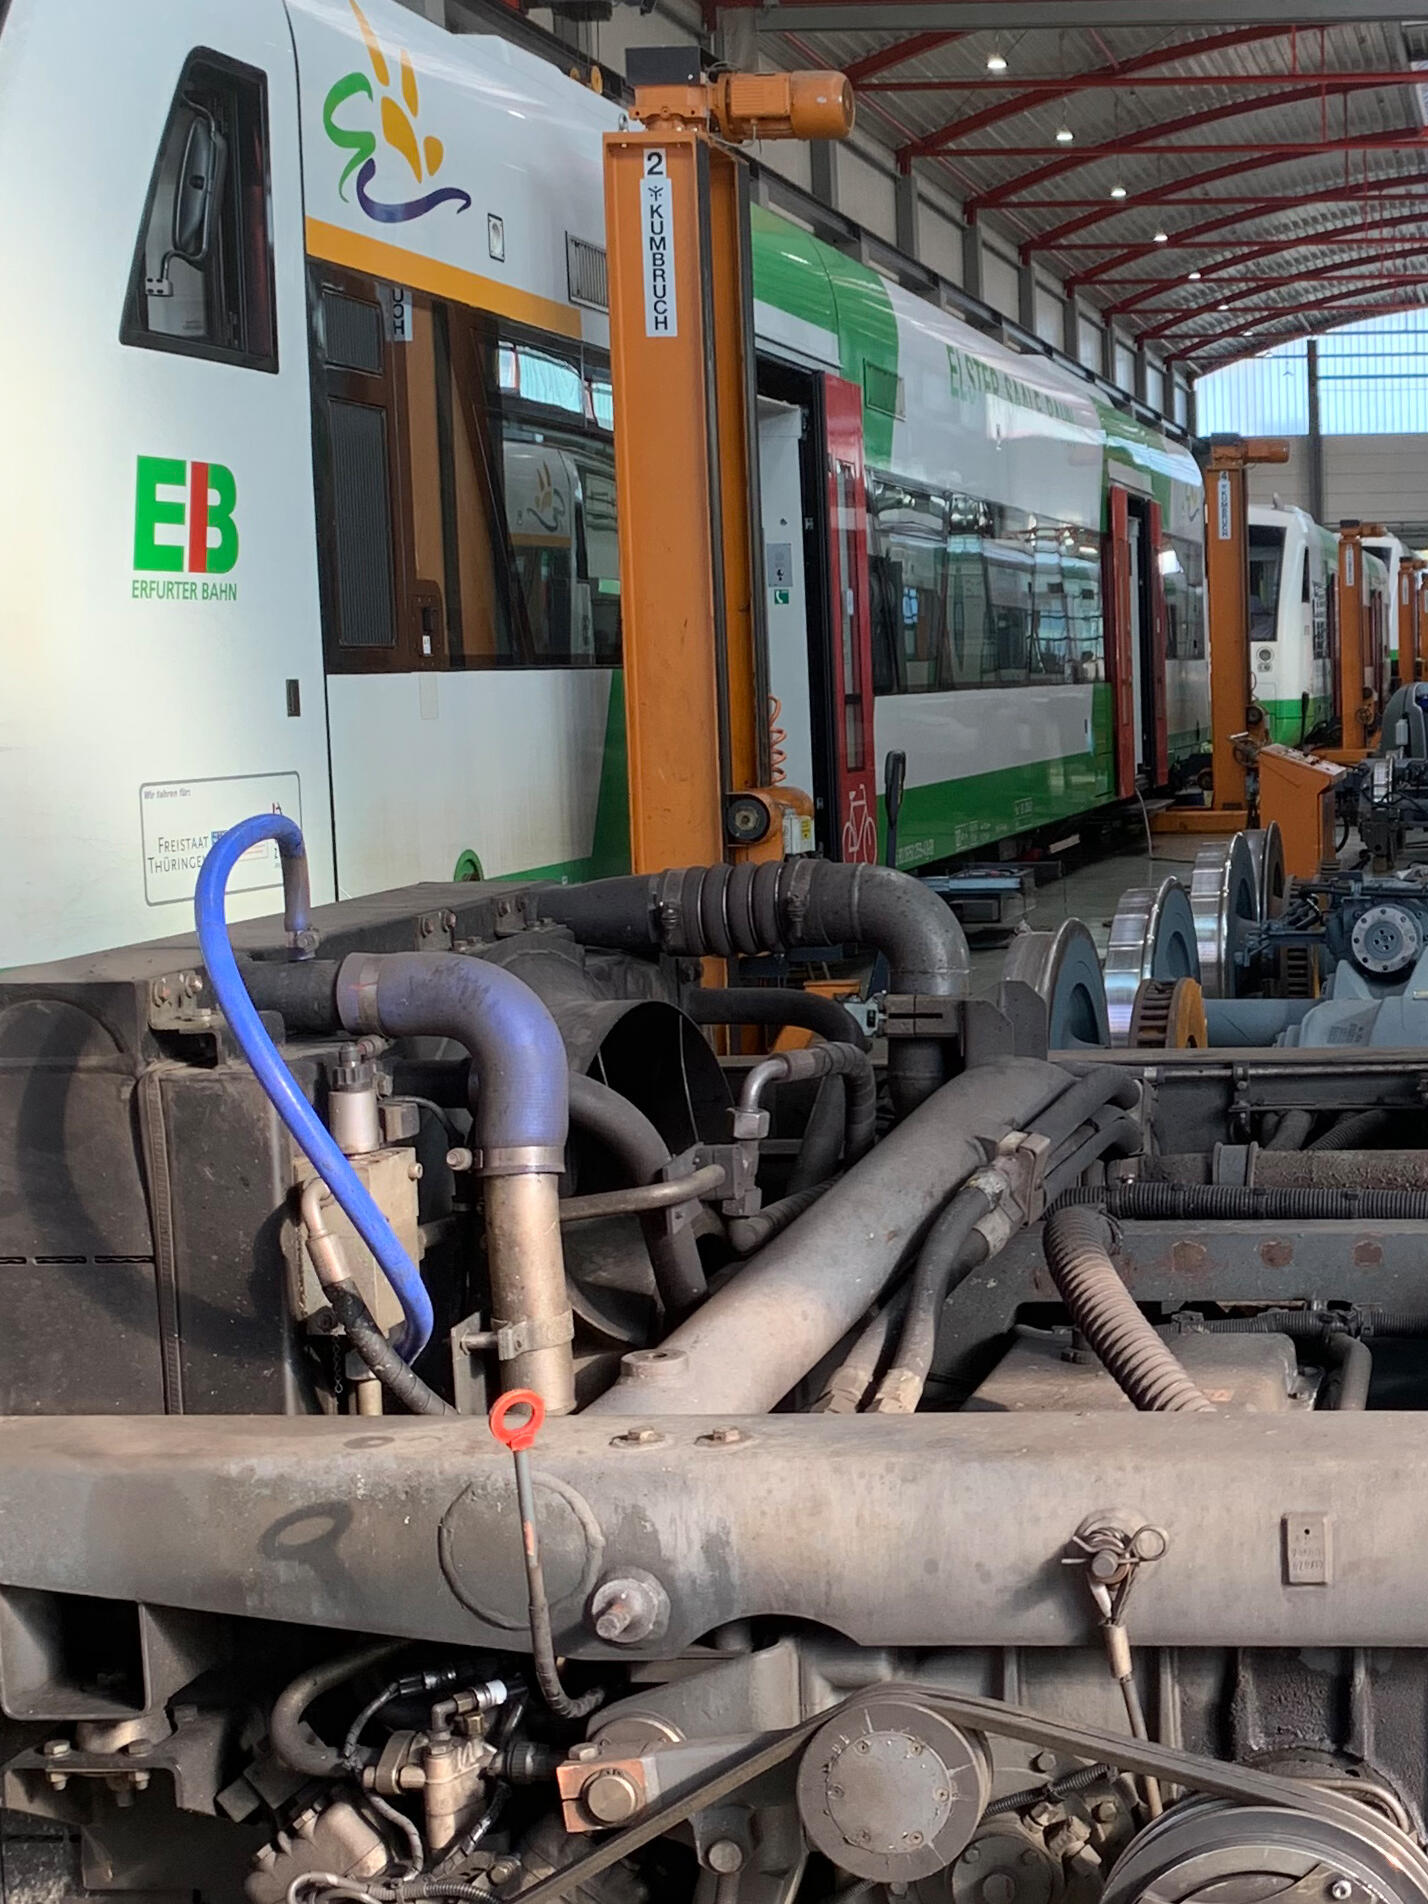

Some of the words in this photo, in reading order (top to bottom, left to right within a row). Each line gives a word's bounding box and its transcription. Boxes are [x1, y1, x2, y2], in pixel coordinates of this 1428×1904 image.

[646, 151, 664, 176] 2
[649, 203, 669, 331] KUMBRUCH
[131, 579, 198, 600] ERFURTER
[201, 582, 237, 601] BAHN
